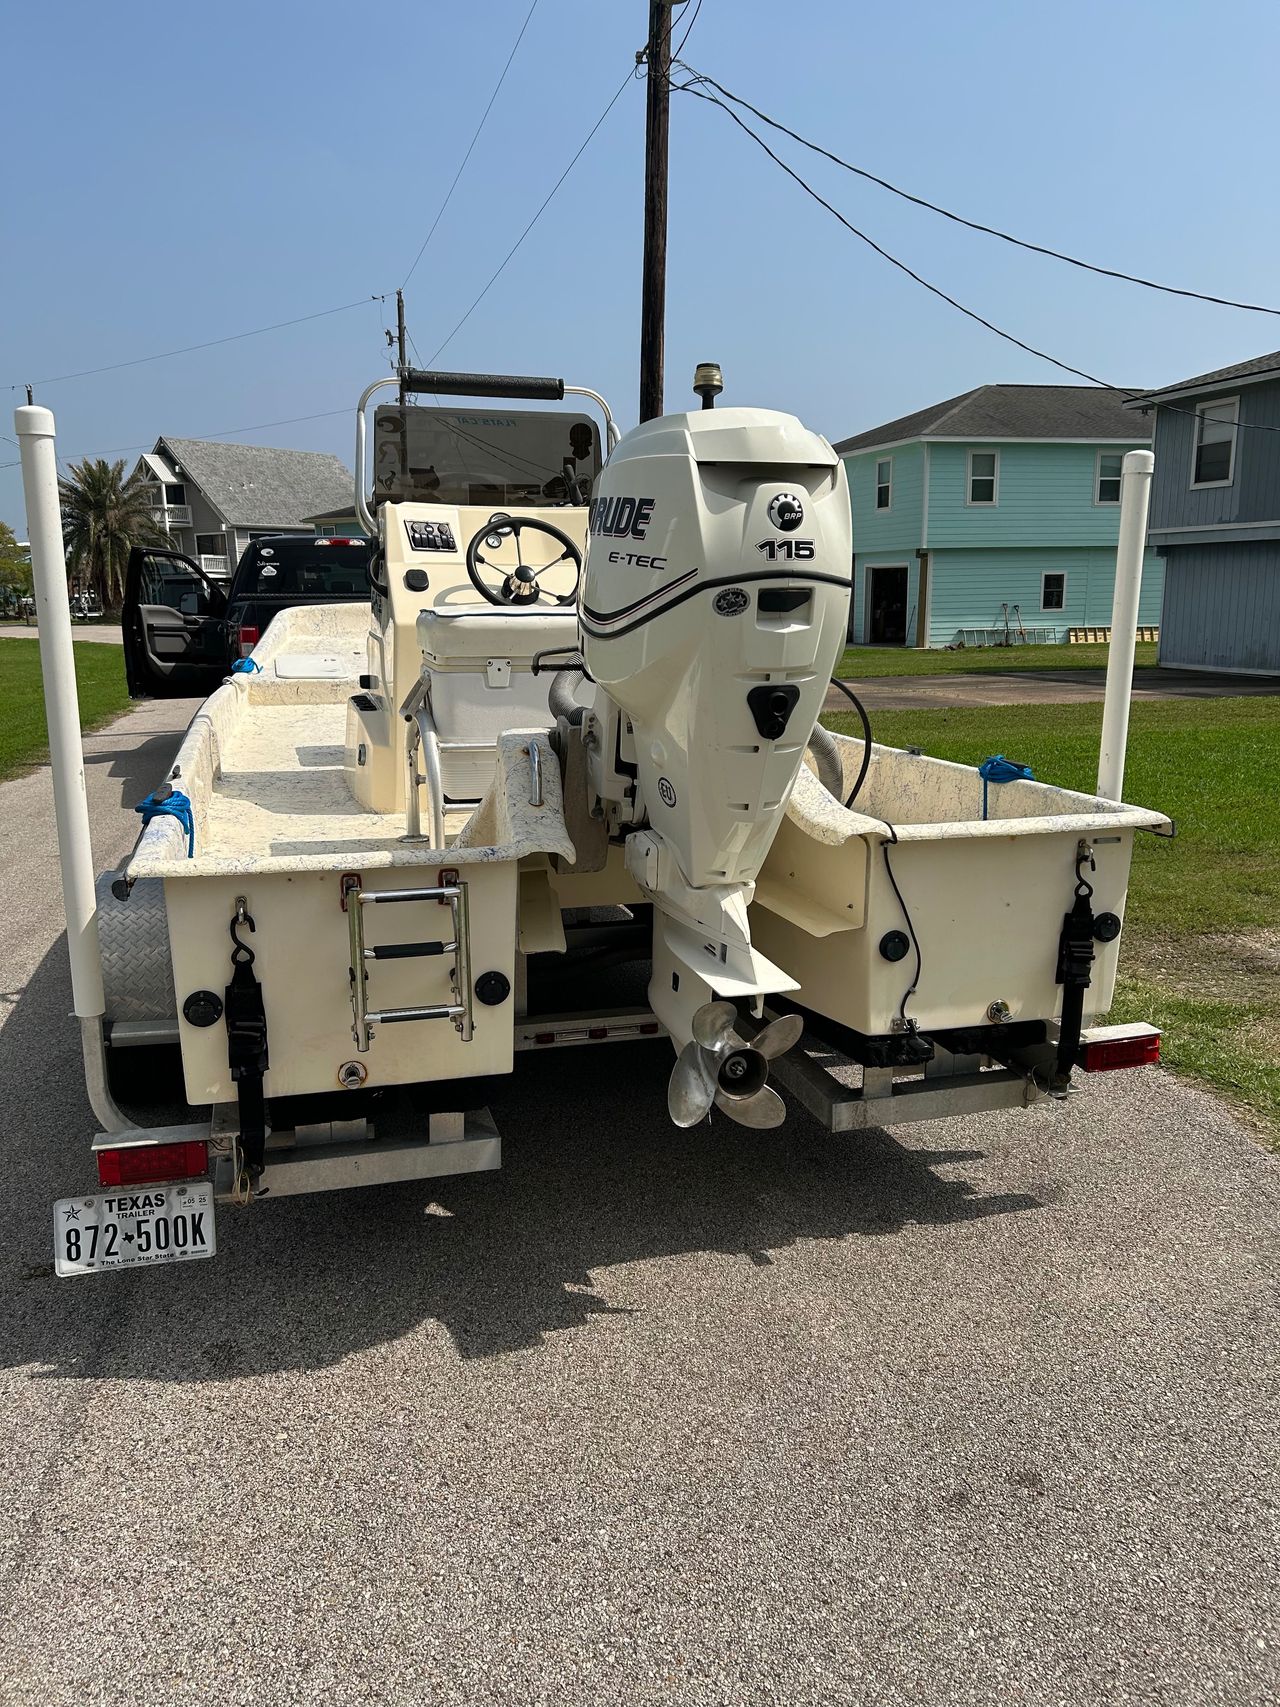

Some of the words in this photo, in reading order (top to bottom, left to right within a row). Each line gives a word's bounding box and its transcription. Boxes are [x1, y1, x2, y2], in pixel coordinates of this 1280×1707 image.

[783, 512, 803, 520] BRP
[755, 538, 816, 561] 115
[608, 551, 668, 570] E-TEC
[104, 1193, 166, 1213] TEXAS
[115, 1209, 156, 1220] TRAILER
[65, 1223, 119, 1262] 872
[136, 1212, 206, 1253] 500K
[117, 1256, 136, 1264] Lone
[155, 1252, 175, 1260] State
